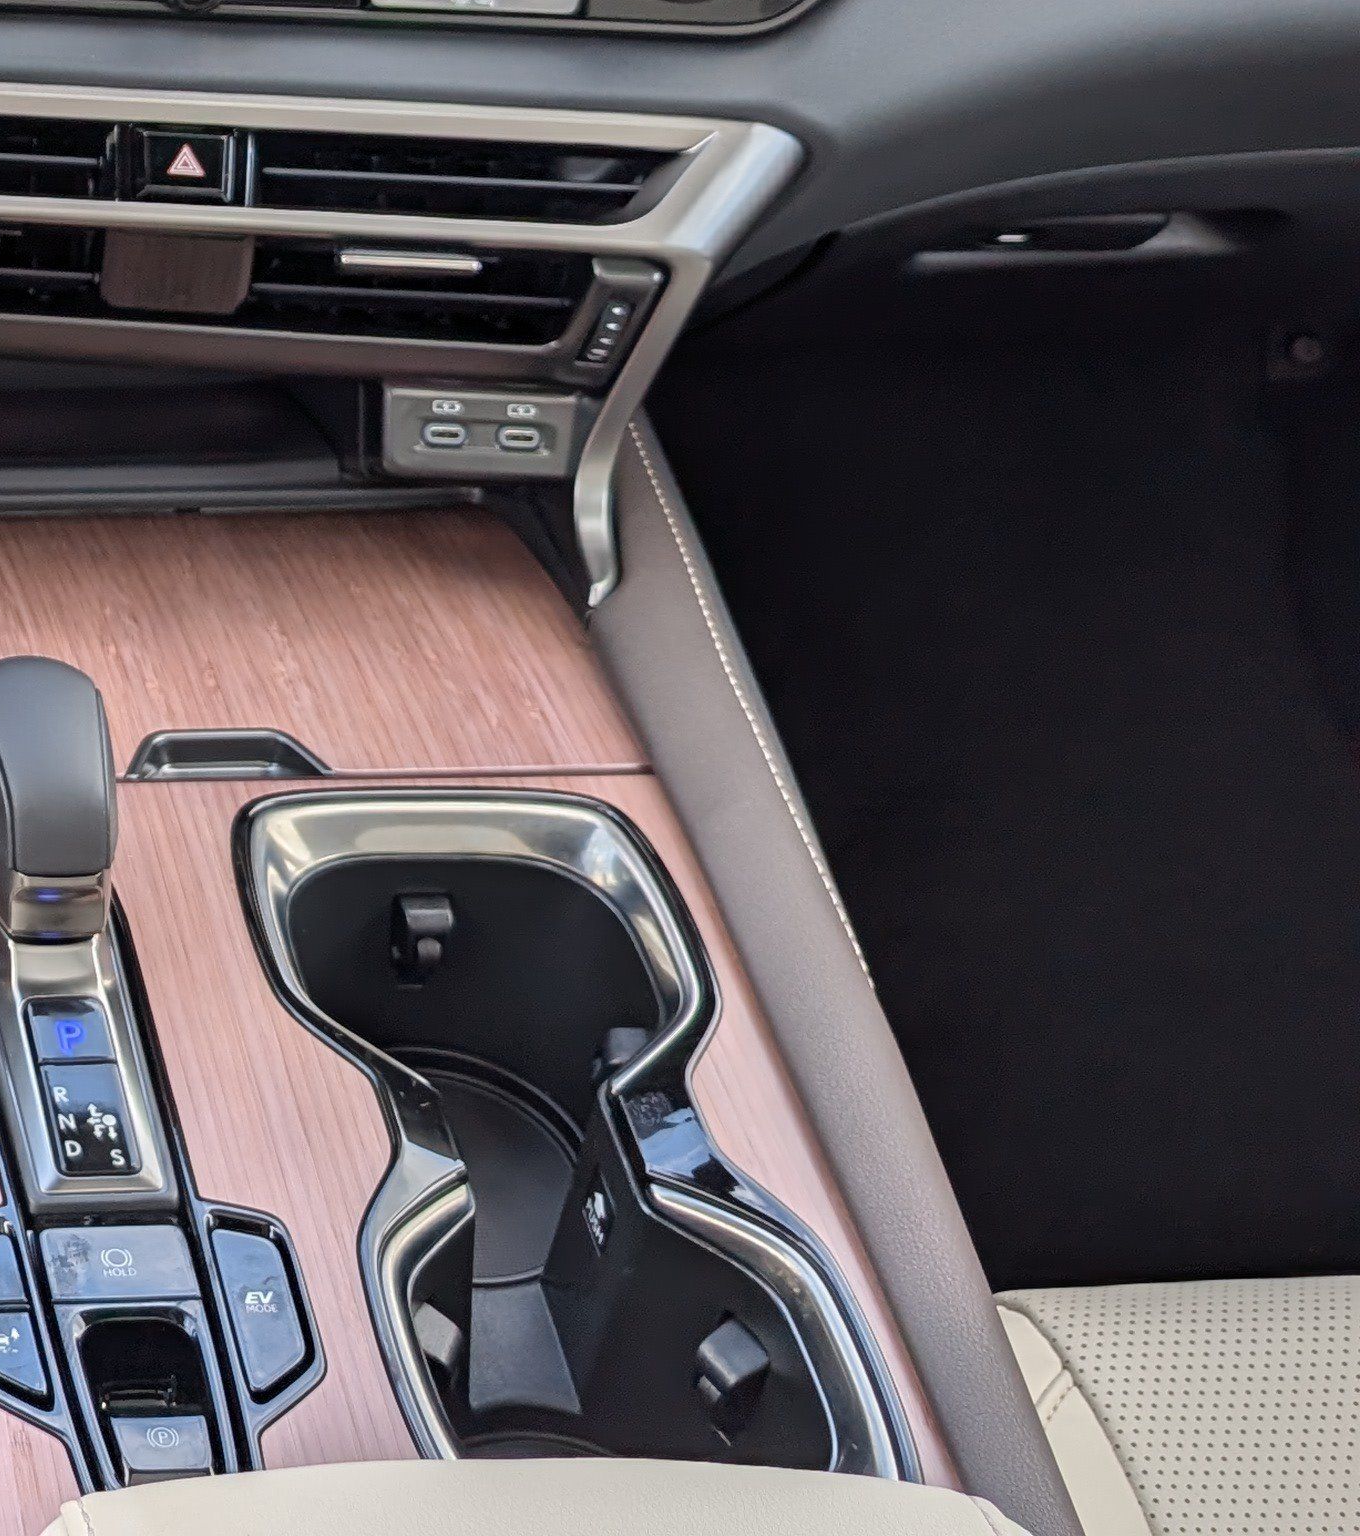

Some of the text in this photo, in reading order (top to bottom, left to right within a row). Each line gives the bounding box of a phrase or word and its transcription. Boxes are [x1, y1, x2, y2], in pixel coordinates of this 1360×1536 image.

[56, 1019, 86, 1055] P
[53, 1086, 70, 1104] R
[58, 1113, 77, 1132] N
[64, 1140, 83, 1158] D
[110, 1149, 125, 1166] S
[102, 1267, 137, 1277] HOLD
[244, 1291, 273, 1304] EV
[245, 1303, 278, 1313] MODE
